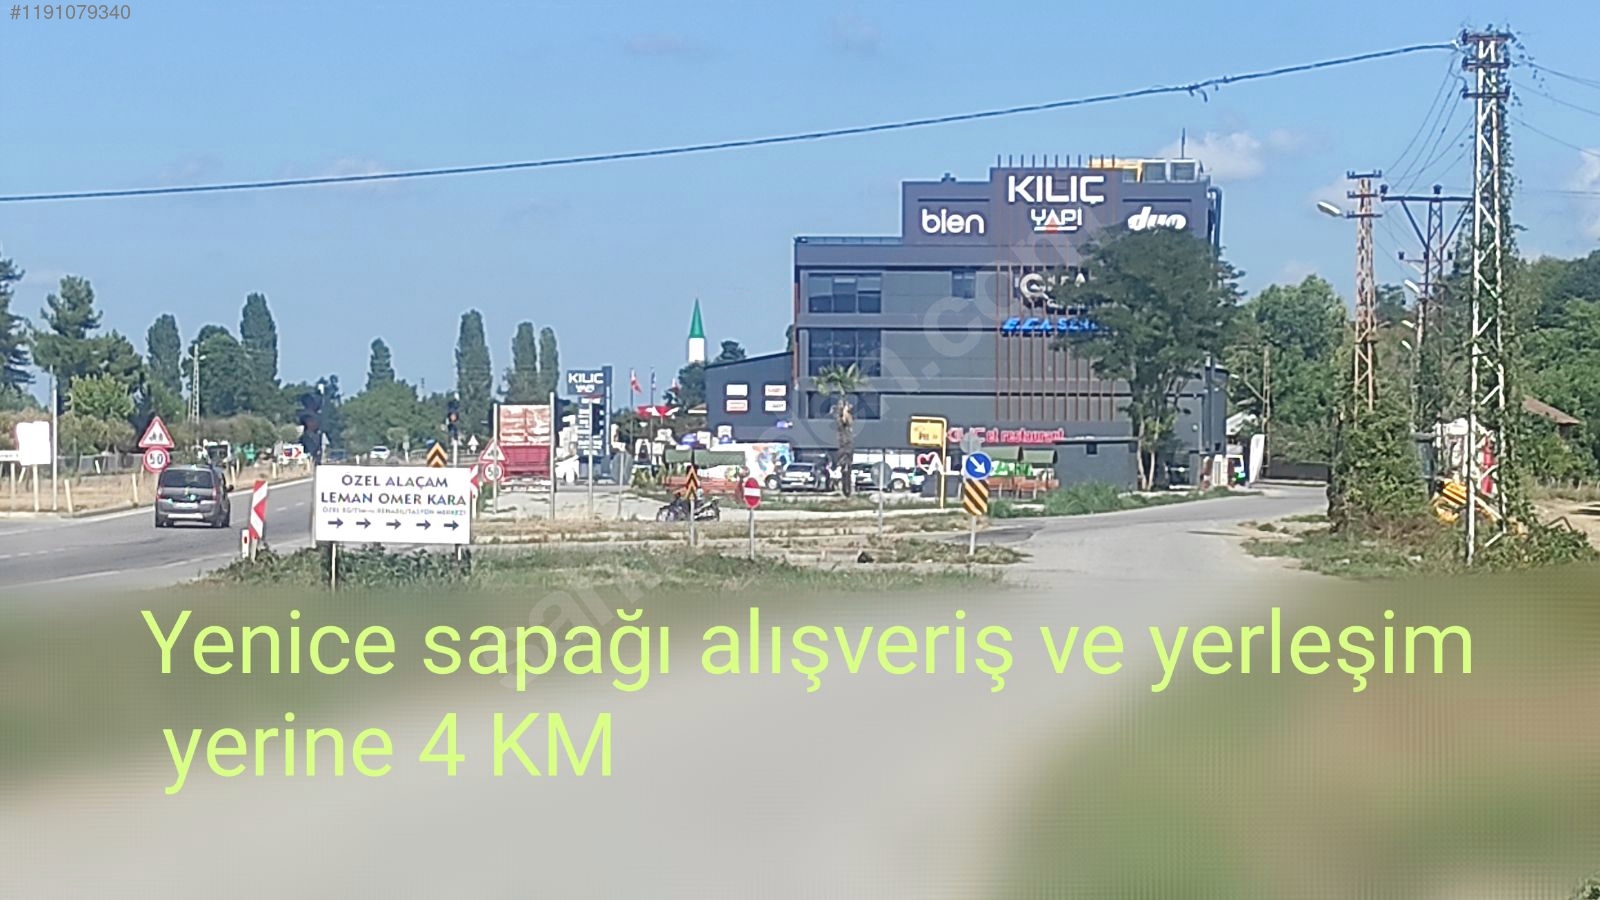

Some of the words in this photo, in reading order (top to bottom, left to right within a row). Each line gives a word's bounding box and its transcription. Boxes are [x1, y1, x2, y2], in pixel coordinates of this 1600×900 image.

[1007, 175, 1105, 206] KILIÇ
[921, 208, 985, 234] bien
[149, 454, 163, 465] 50
[385, 476, 449, 489] ALAÇAM
[321, 492, 373, 504] LEMAN
[427, 494, 467, 506] KARA
